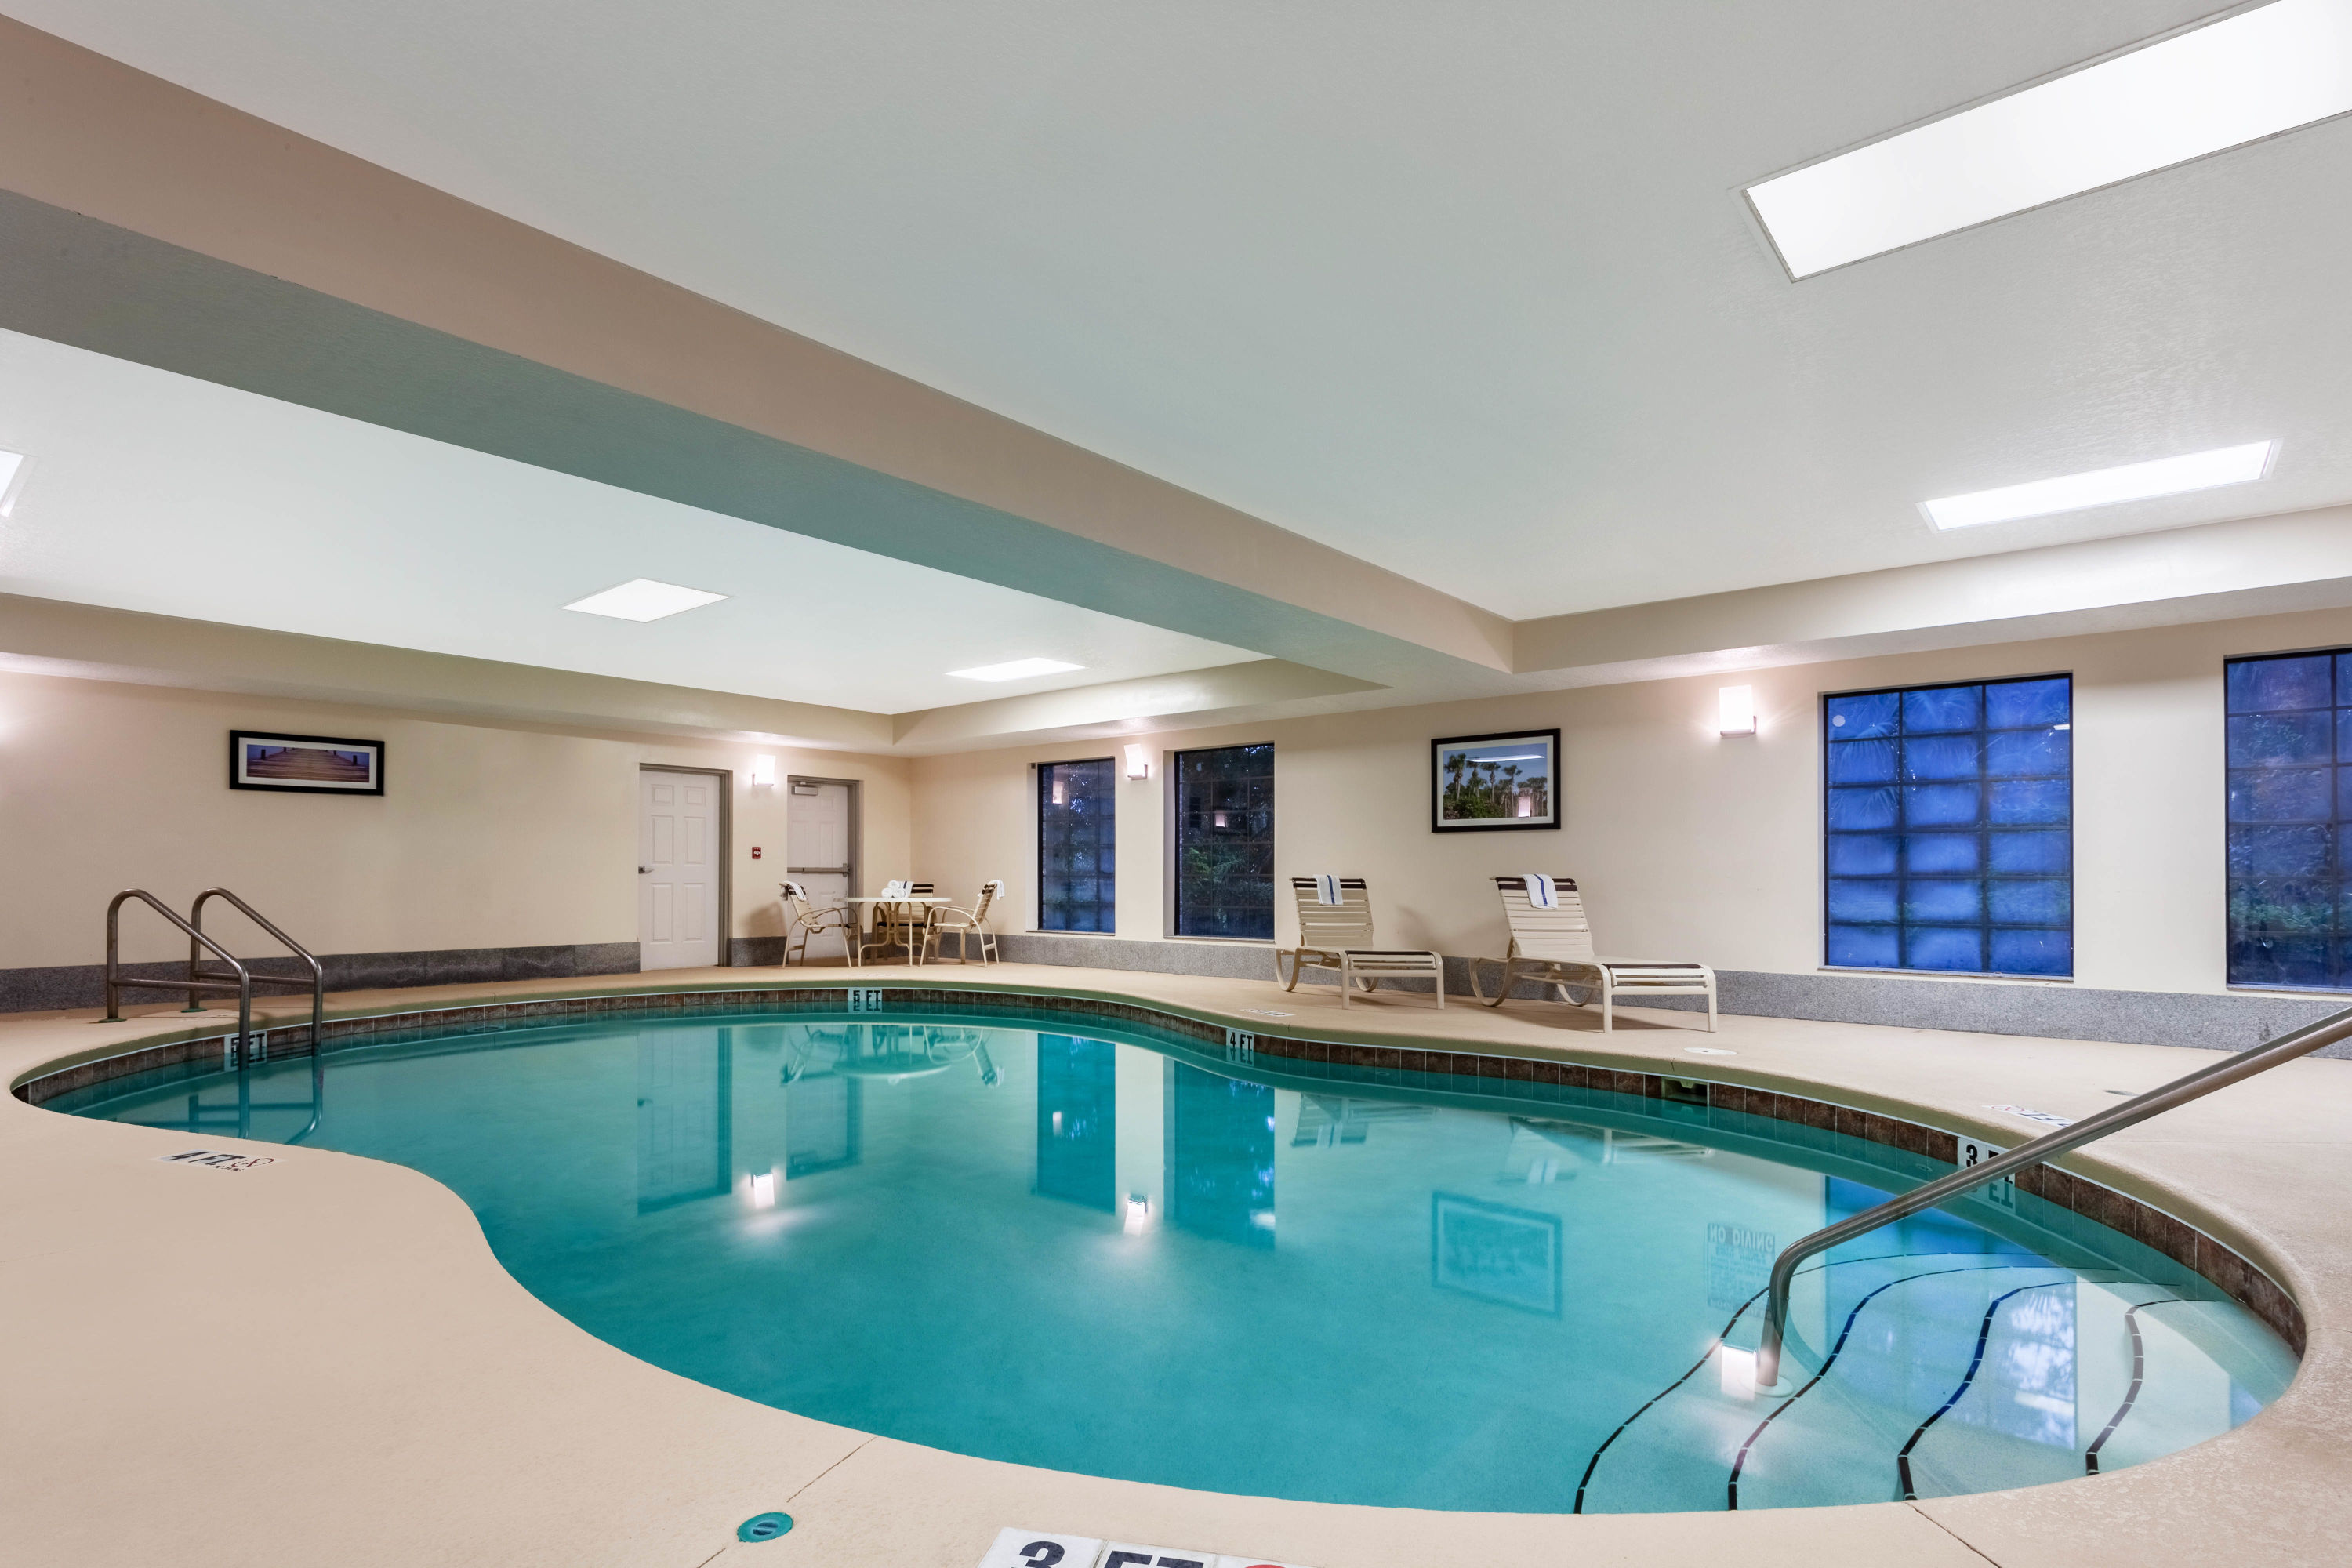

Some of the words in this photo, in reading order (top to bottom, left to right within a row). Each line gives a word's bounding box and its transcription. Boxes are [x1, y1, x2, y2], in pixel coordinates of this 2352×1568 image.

[853, 989, 861, 1002] 5
[1229, 1031, 1236, 1048] 4
[169, 1151, 209, 1160] 4
[1965, 1144, 1978, 1168] 3
